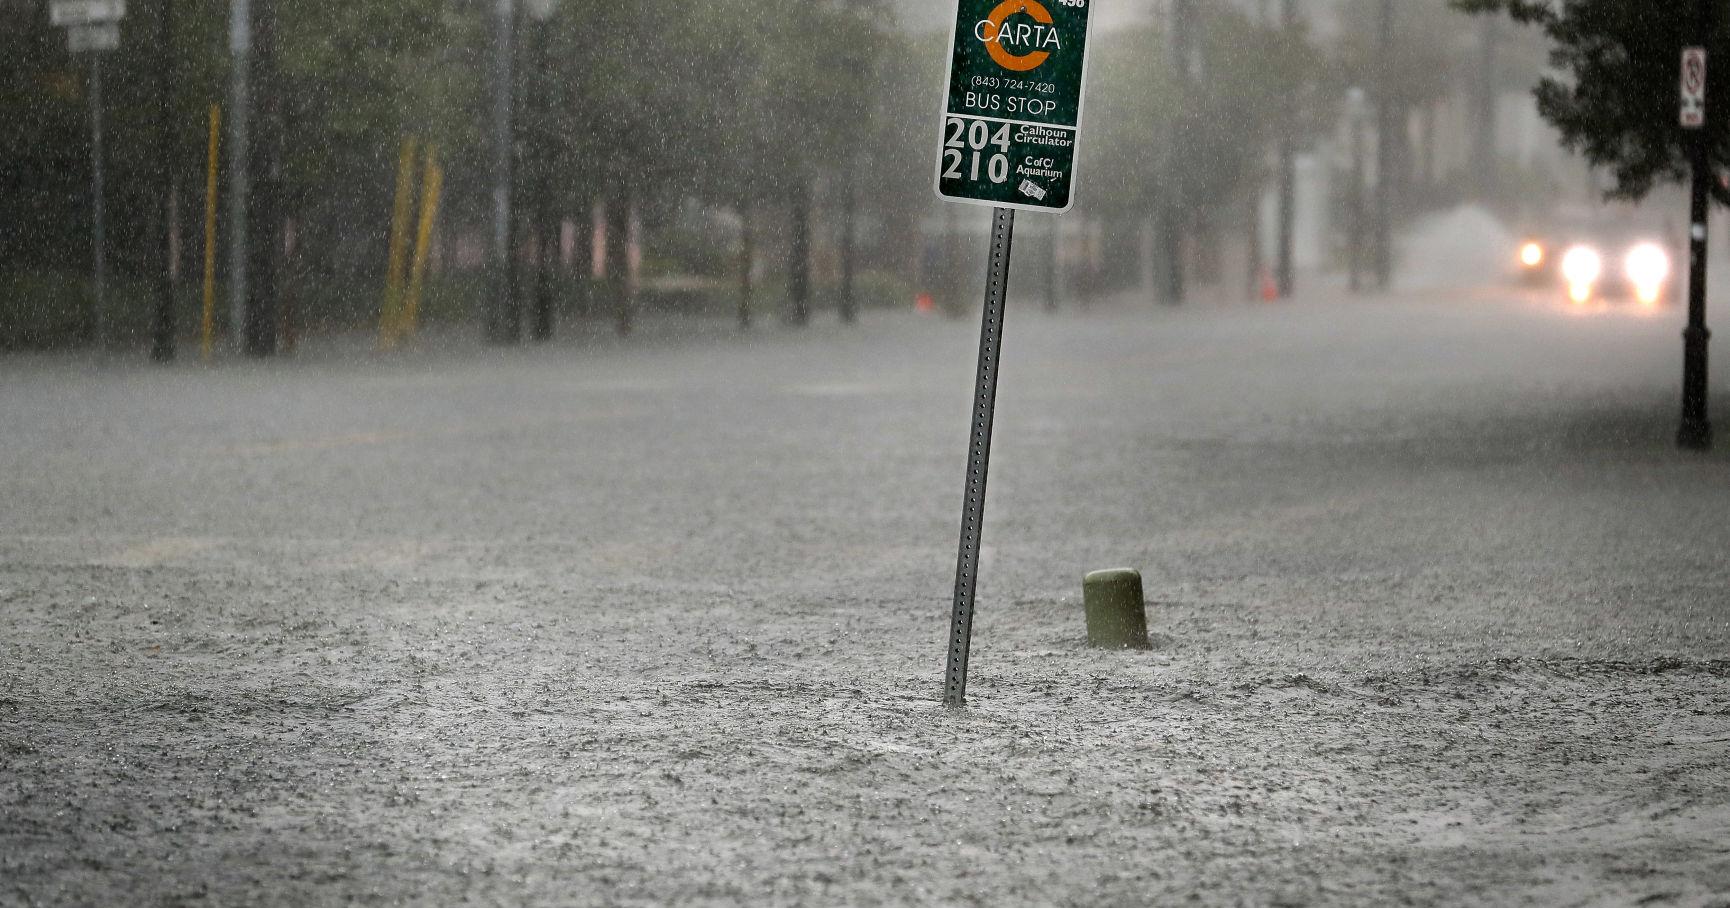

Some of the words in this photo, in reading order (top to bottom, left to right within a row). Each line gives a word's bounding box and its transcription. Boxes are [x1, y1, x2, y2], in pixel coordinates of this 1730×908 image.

[975, 19, 1061, 50] CARTA
[971, 75, 1000, 89] (843)
[1004, 78, 1055, 94] 724-7420
[965, 91, 1000, 110] BUS
[1007, 96, 1056, 115] STOP
[945, 117, 1011, 153] 204
[1014, 132, 1072, 147] Circulator
[1020, 124, 1067, 138] Calhoun
[942, 148, 1009, 183] 210
[1016, 164, 1062, 178] Aquarium
